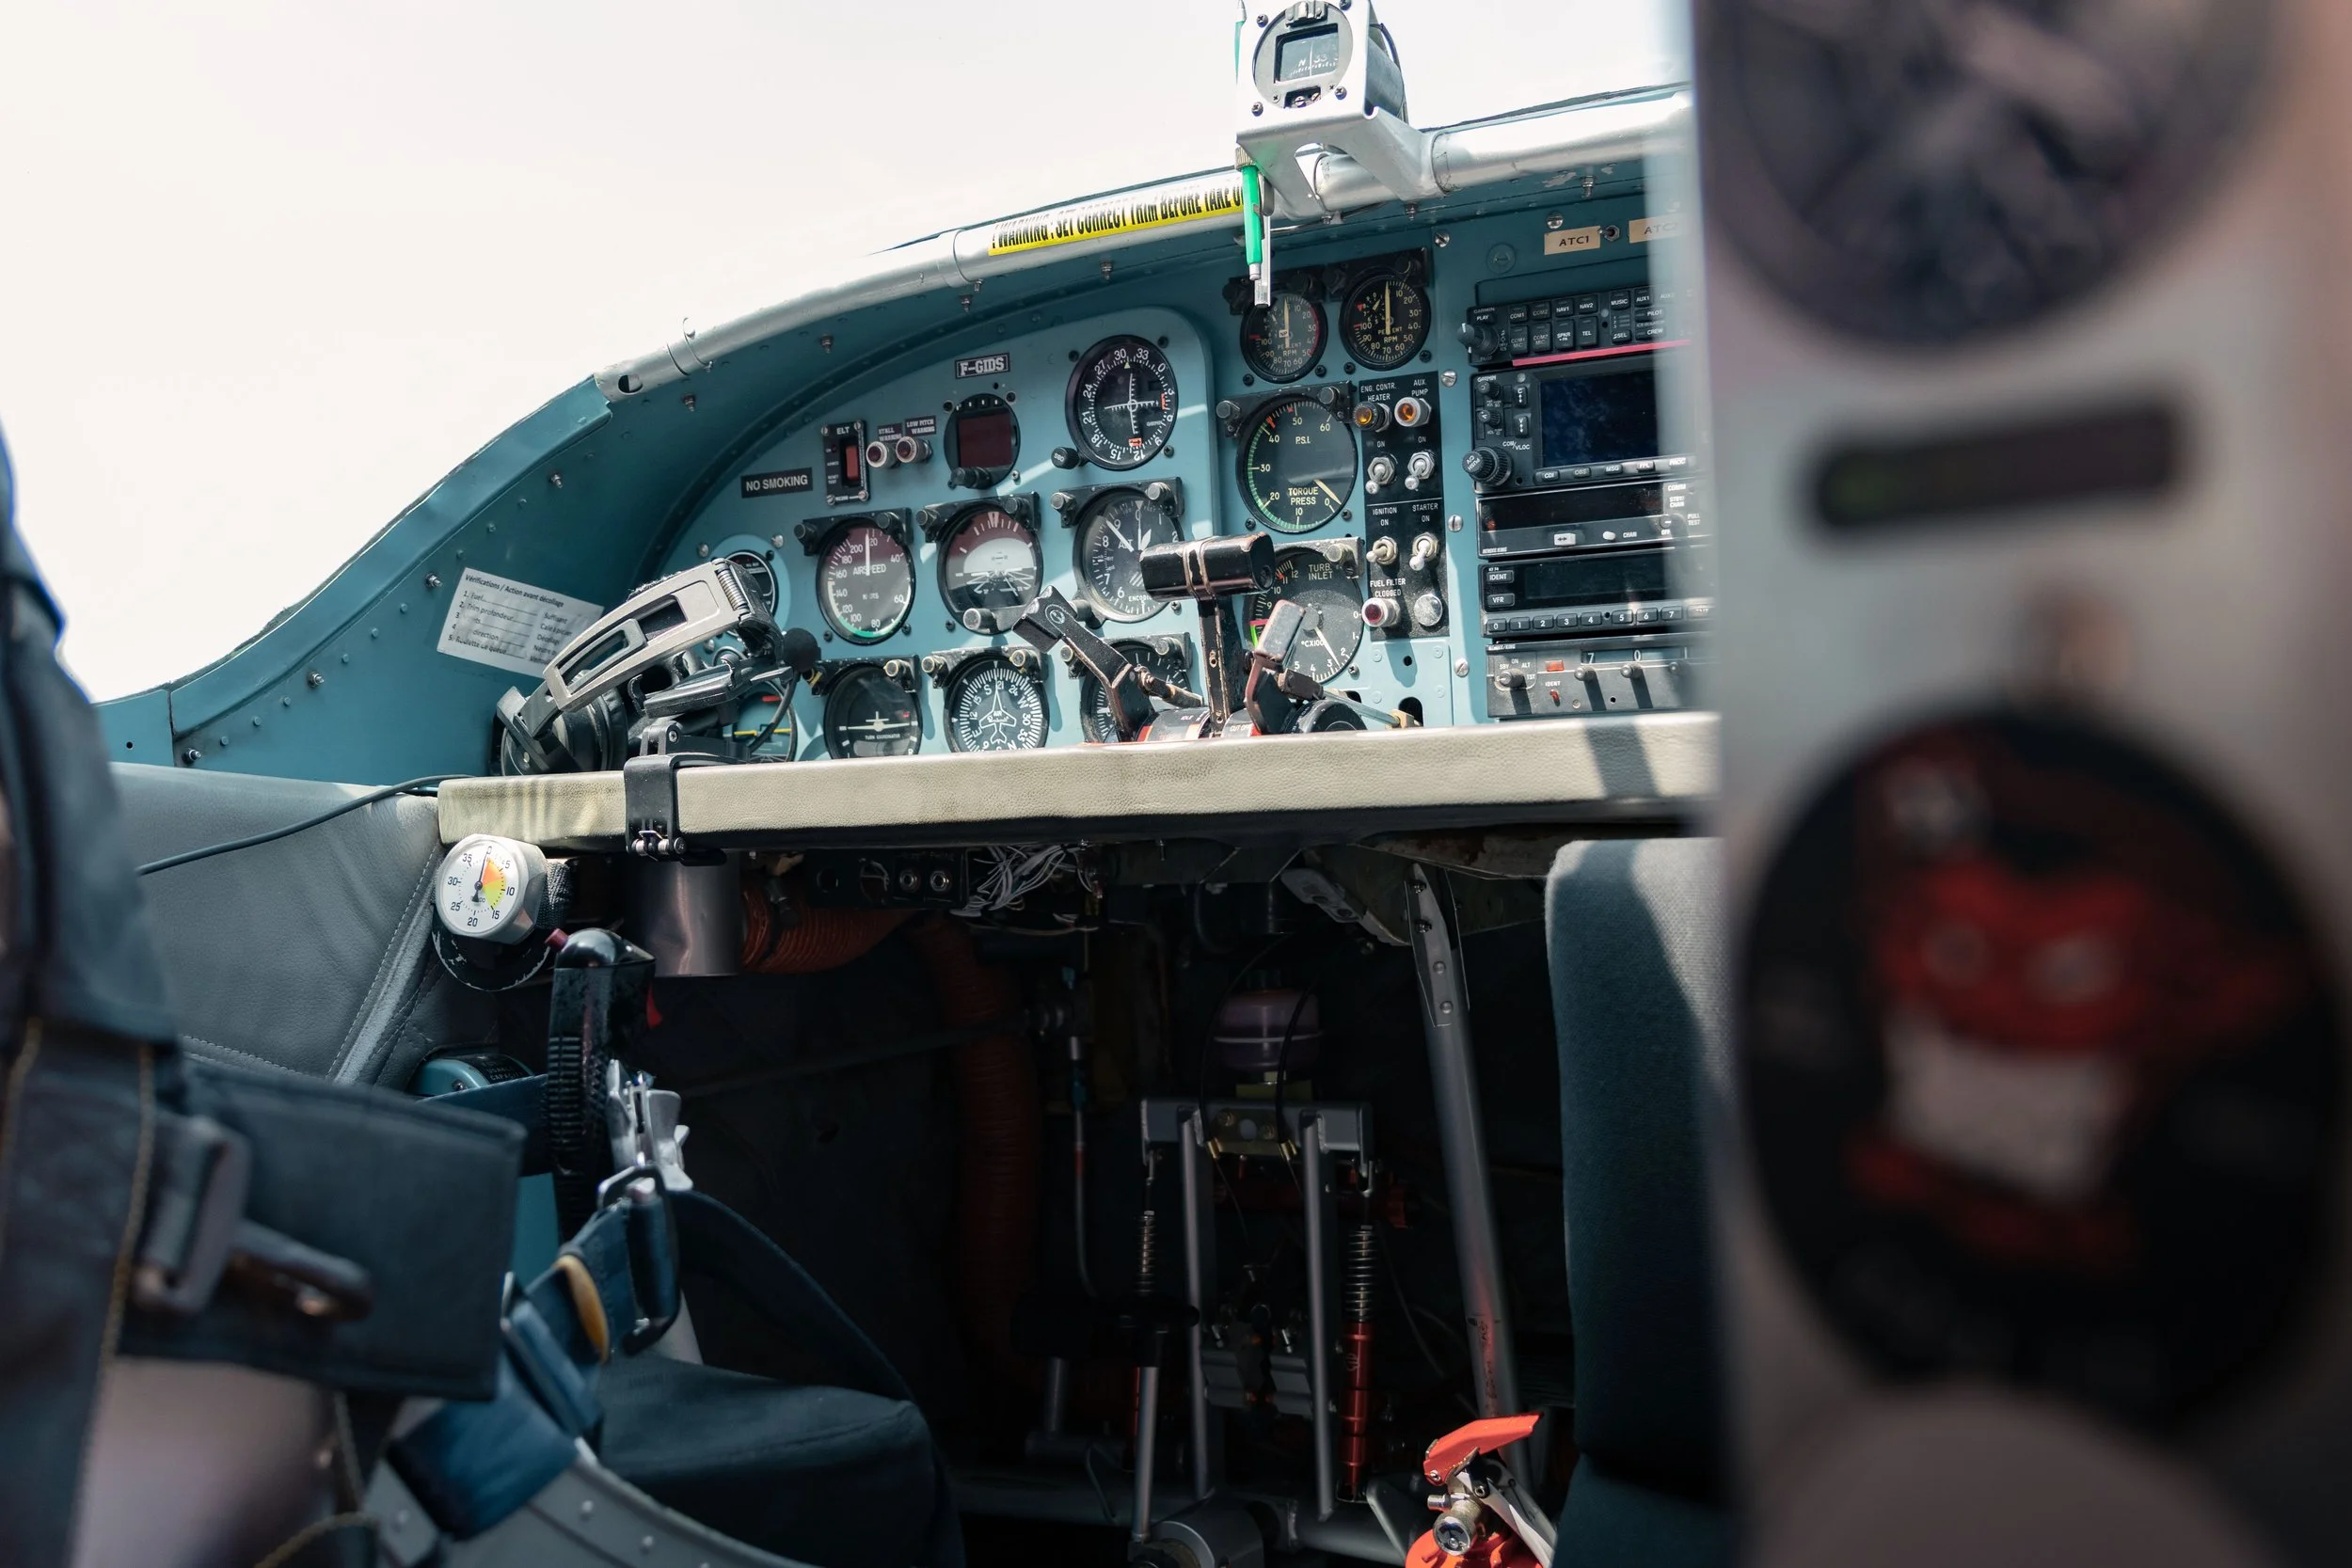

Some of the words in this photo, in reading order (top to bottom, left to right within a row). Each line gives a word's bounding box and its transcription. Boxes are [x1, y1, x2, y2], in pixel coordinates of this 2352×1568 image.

[997, 215, 1048, 247] WARNING
[1056, 210, 1074, 238] SET
[1077, 200, 1126, 235] CORRECT
[1130, 198, 1158, 225] TRIM
[1160, 189, 1201, 223] BEFORE
[1204, 186, 1232, 213] TAKE
[1644, 222, 1678, 235] ATC2
[1559, 236, 1590, 247] ATC1
[1404, 296, 1413, 305] 20
[1403, 334, 1413, 342] 50
[1114, 348, 1127, 360] 30
[1136, 348, 1150, 360] 33
[960, 356, 1005, 376] F-GIDS
[1094, 359, 1107, 375] 27
[1083, 383, 1093, 398] 24
[1375, 383, 1396, 391] CONTR.
[1411, 388, 1428, 397] PUMP
[1367, 393, 1391, 402] HEATER
[1083, 411, 1093, 424] 21
[1292, 417, 1303, 425] 50
[836, 426, 850, 435] ELT
[911, 426, 935, 435] WARNING
[1320, 423, 1330, 432] 60
[879, 434, 902, 442] WARNING
[1091, 434, 1104, 448] 18
[1269, 435, 1279, 443] 40
[1110, 450, 1122, 461] 15
[1134, 450, 1146, 461] 12
[1260, 464, 1270, 472] 30
[746, 479, 760, 491] NO
[762, 474, 808, 490] SMOKING
[1270, 492, 1279, 500] 20
[1288, 487, 1318, 496] TORQUE
[1324, 498, 1330, 506] 0
[1372, 507, 1397, 515] IGNITION
[1412, 502, 1438, 512] STARTER
[1295, 508, 1303, 516] 10
[1102, 535, 1109, 547] 8
[1171, 531, 1179, 543] 2
[850, 544, 864, 553] 200
[841, 555, 852, 564] 180
[890, 554, 900, 563] 40
[853, 563, 886, 576] AIRSEED
[1309, 563, 1332, 572] TURB.
[835, 569, 848, 578] 160
[1291, 570, 1298, 578] 12
[1309, 571, 1333, 580] INLET
[1104, 574, 1110, 585] 7
[1370, 579, 1385, 588] FUEL
[1386, 578, 1406, 586] FILTER
[465, 574, 501, 590] Vérifications
[504, 586, 523, 596] Action
[539, 593, 564, 608] décollage
[835, 589, 848, 597] 140
[1117, 587, 1125, 598] 6
[1273, 586, 1281, 594] 10
[1375, 589, 1401, 597] CLOGGED
[894, 594, 904, 604] 60
[467, 603, 480, 611] Trim
[480, 609, 514, 621] profondeur
[842, 605, 852, 613] 120
[850, 613, 862, 622] 100
[871, 619, 881, 628] 80
[472, 630, 499, 641] direction
[1633, 650, 1642, 662] 0
[1295, 661, 1300, 670] 5
[983, 684, 993, 695] S
[1009, 685, 1018, 696] 24
[973, 695, 982, 705] 15
[1017, 696, 1029, 709] W
[969, 711, 977, 721] 12
[1023, 713, 1031, 725] 30
[1017, 728, 1028, 742] 33
[462, 853, 472, 863] 35
[504, 861, 511, 869] 5
[448, 877, 457, 886] 30
[506, 886, 515, 896] 10
[451, 902, 461, 911] 25
[492, 910, 500, 919] 15
[468, 917, 478, 927] 20
